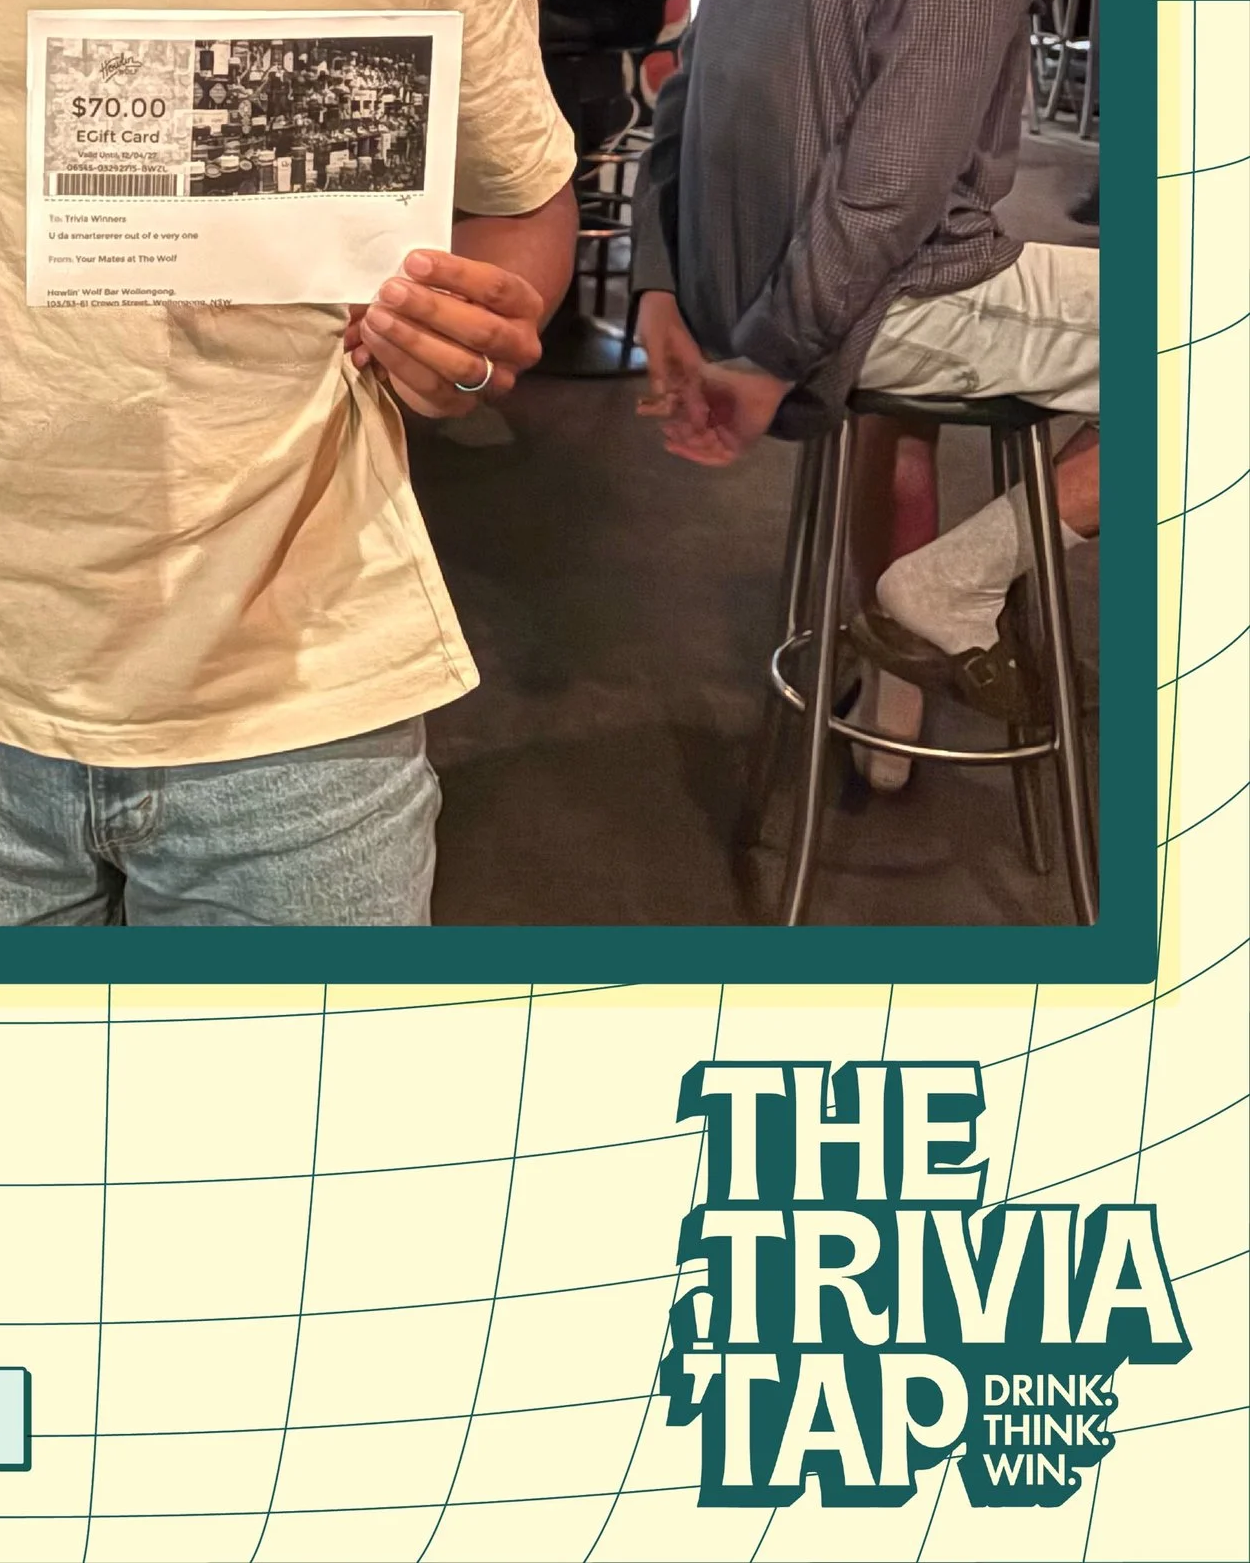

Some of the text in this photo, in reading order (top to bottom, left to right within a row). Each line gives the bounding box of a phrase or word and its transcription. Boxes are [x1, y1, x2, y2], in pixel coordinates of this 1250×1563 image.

[72, 96, 166, 118] $70.00
[76, 129, 160, 143] EGift Card
[65, 214, 88, 223] Trivia
[91, 215, 126, 223] Winners
[49, 232, 55, 240] U
[57, 232, 69, 240] da
[124, 232, 140, 240] out
[161, 233, 180, 241] very
[75, 255, 96, 263] Your
[98, 255, 125, 263] Mates
[127, 255, 136, 263] at
[138, 255, 155, 263] The
[156, 254, 178, 262] Wolf
